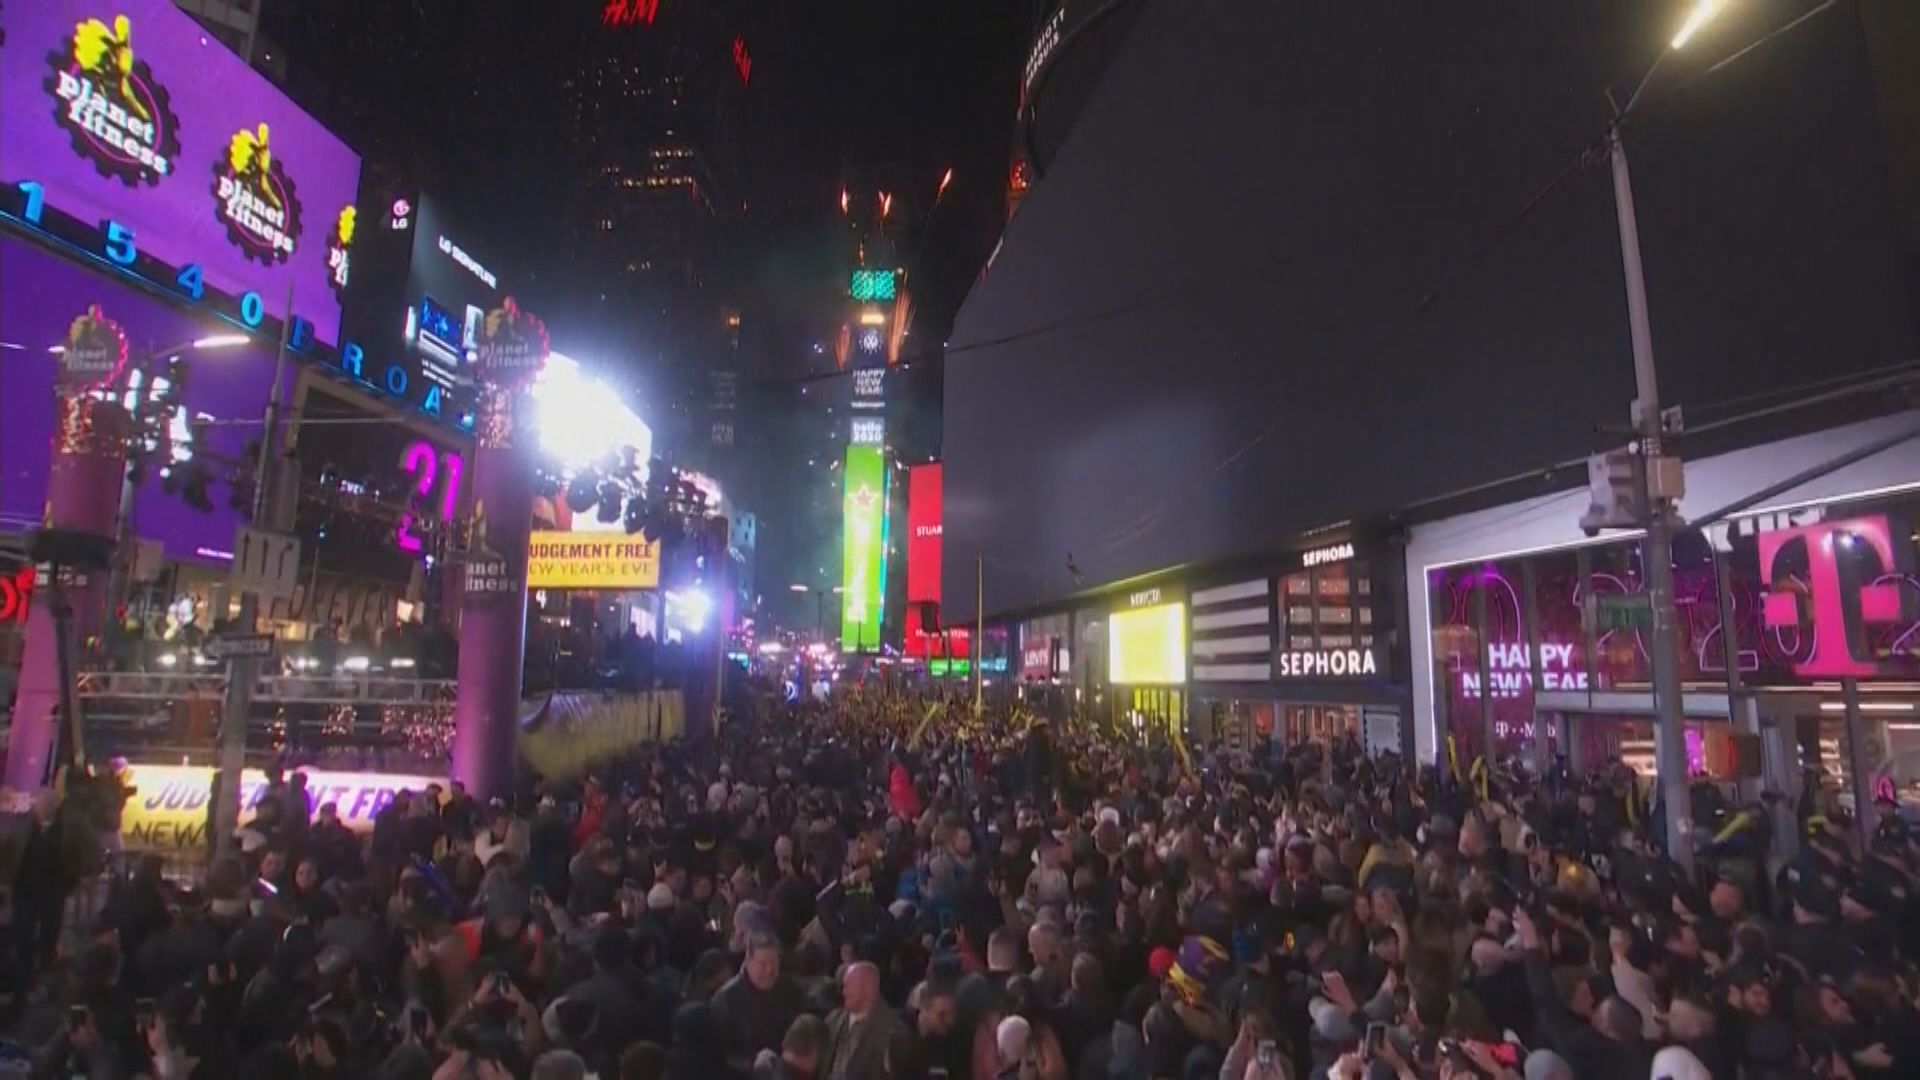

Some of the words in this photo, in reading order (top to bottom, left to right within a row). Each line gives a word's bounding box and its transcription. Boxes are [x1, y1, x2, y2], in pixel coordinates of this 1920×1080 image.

[57, 70, 155, 144] planet
[68, 102, 169, 175] fitness
[217, 176, 285, 228] planet
[225, 203, 293, 253] fitness
[392, 217, 408, 230] LG
[439, 235, 457, 254] LG
[853, 369, 886, 380] HAPPY
[857, 378, 881, 387] NEW
[853, 431, 882, 443] 2020
[528, 543, 612, 558] UDGEMENT
[616, 543, 651, 557] FREE
[1303, 542, 1354, 567] SEPHORA
[529, 563, 553, 576] EW
[1280, 649, 1376, 676] SEPHORA
[130, 820, 205, 848] NEW
